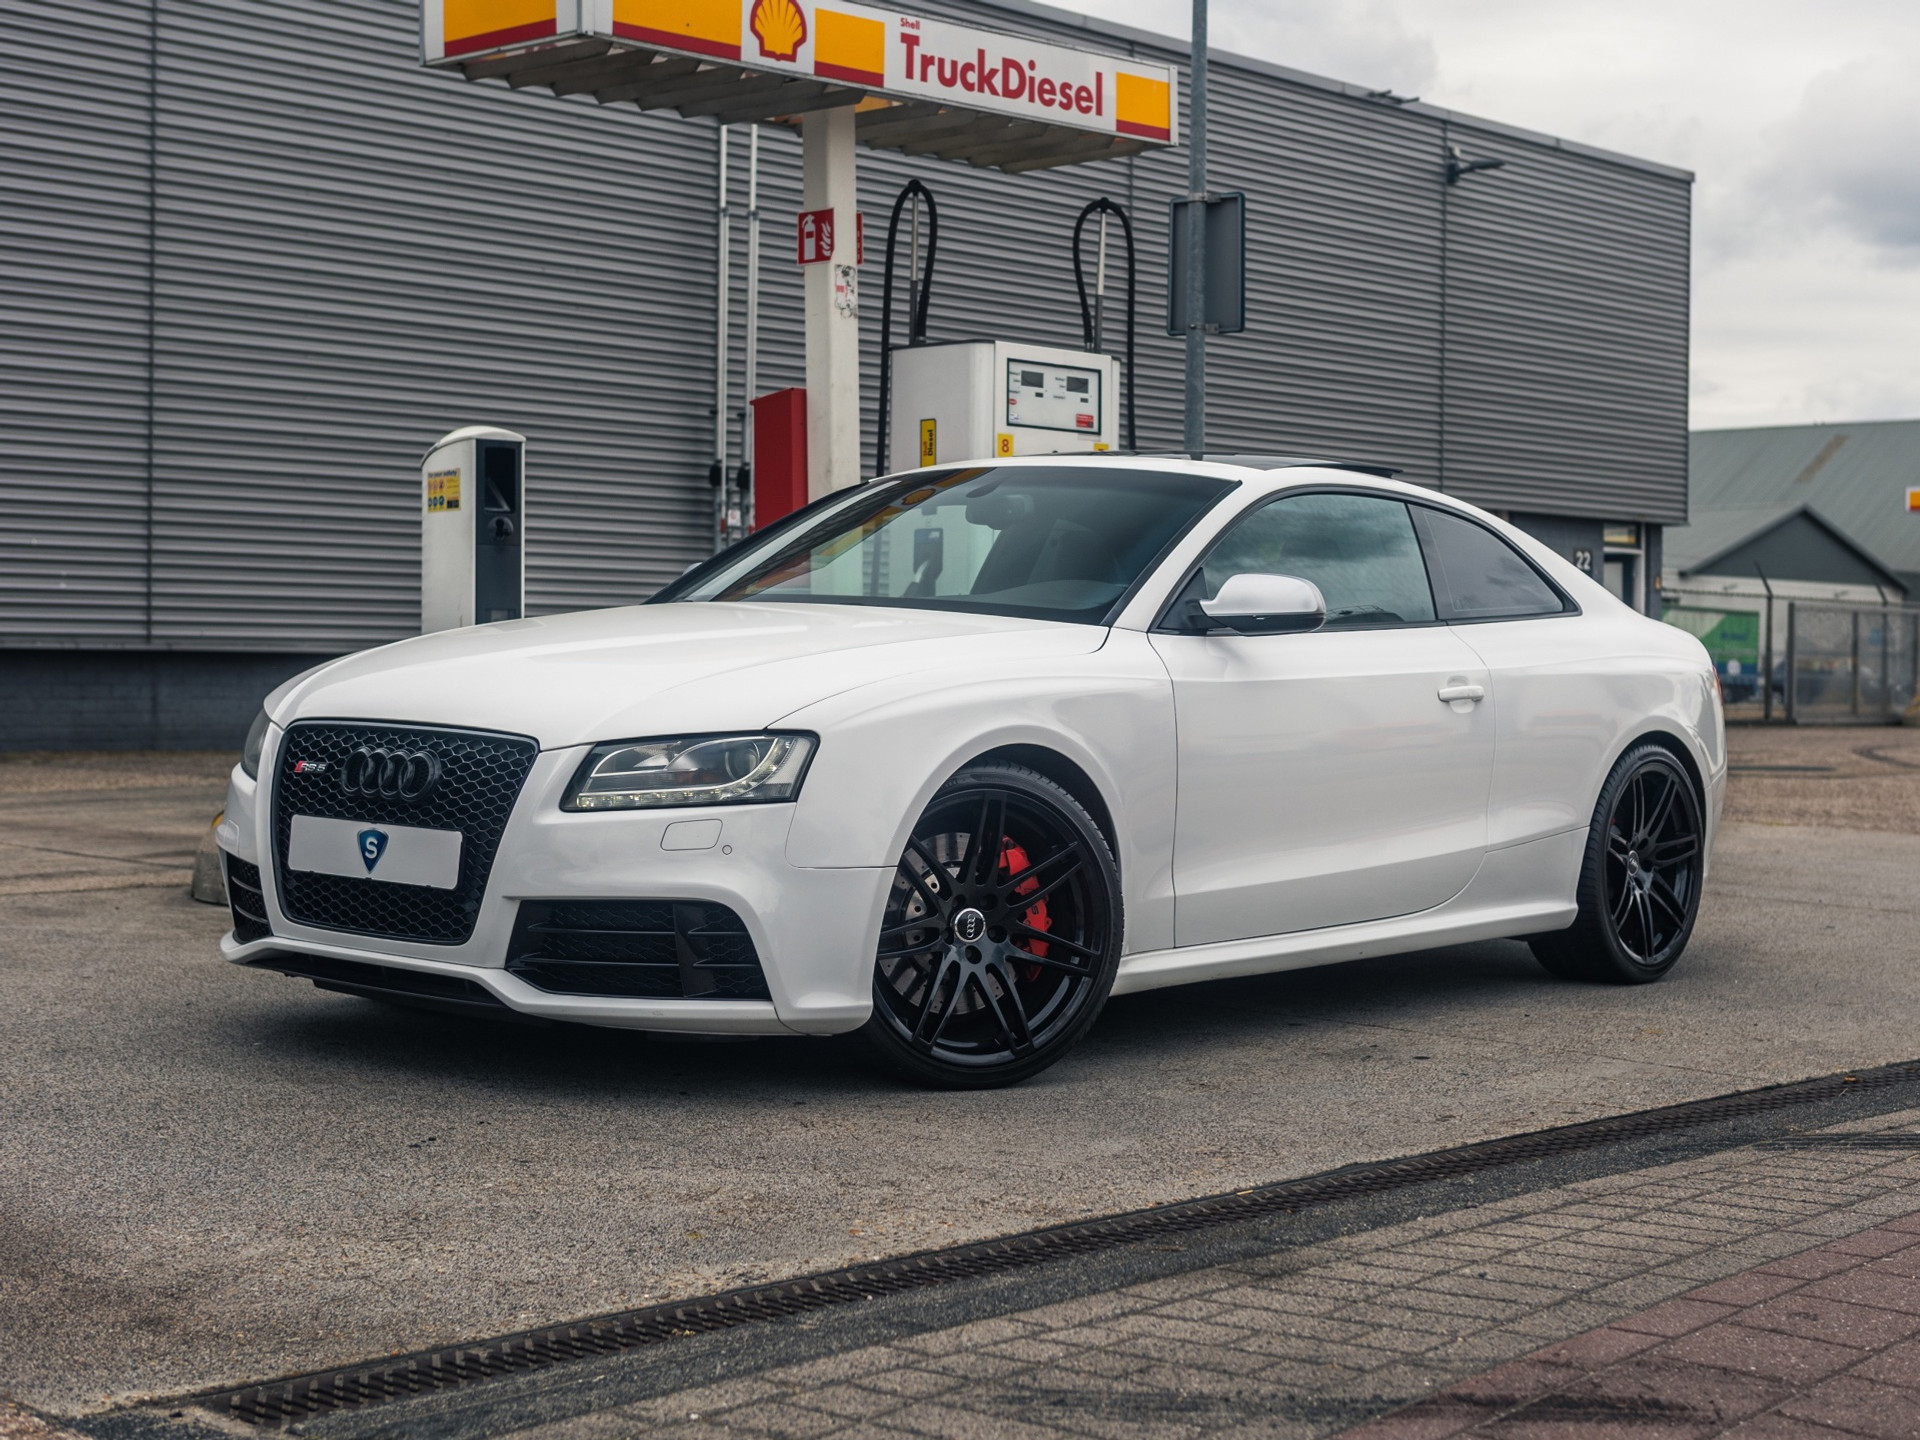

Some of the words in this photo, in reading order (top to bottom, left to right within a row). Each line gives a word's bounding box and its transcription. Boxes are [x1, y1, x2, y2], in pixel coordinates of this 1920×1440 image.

[900, 17, 921, 31] Shell
[900, 32, 1103, 117] TruckDiesel
[1001, 438, 1010, 453] 8
[1575, 550, 1591, 570] 22
[365, 836, 379, 860] S
